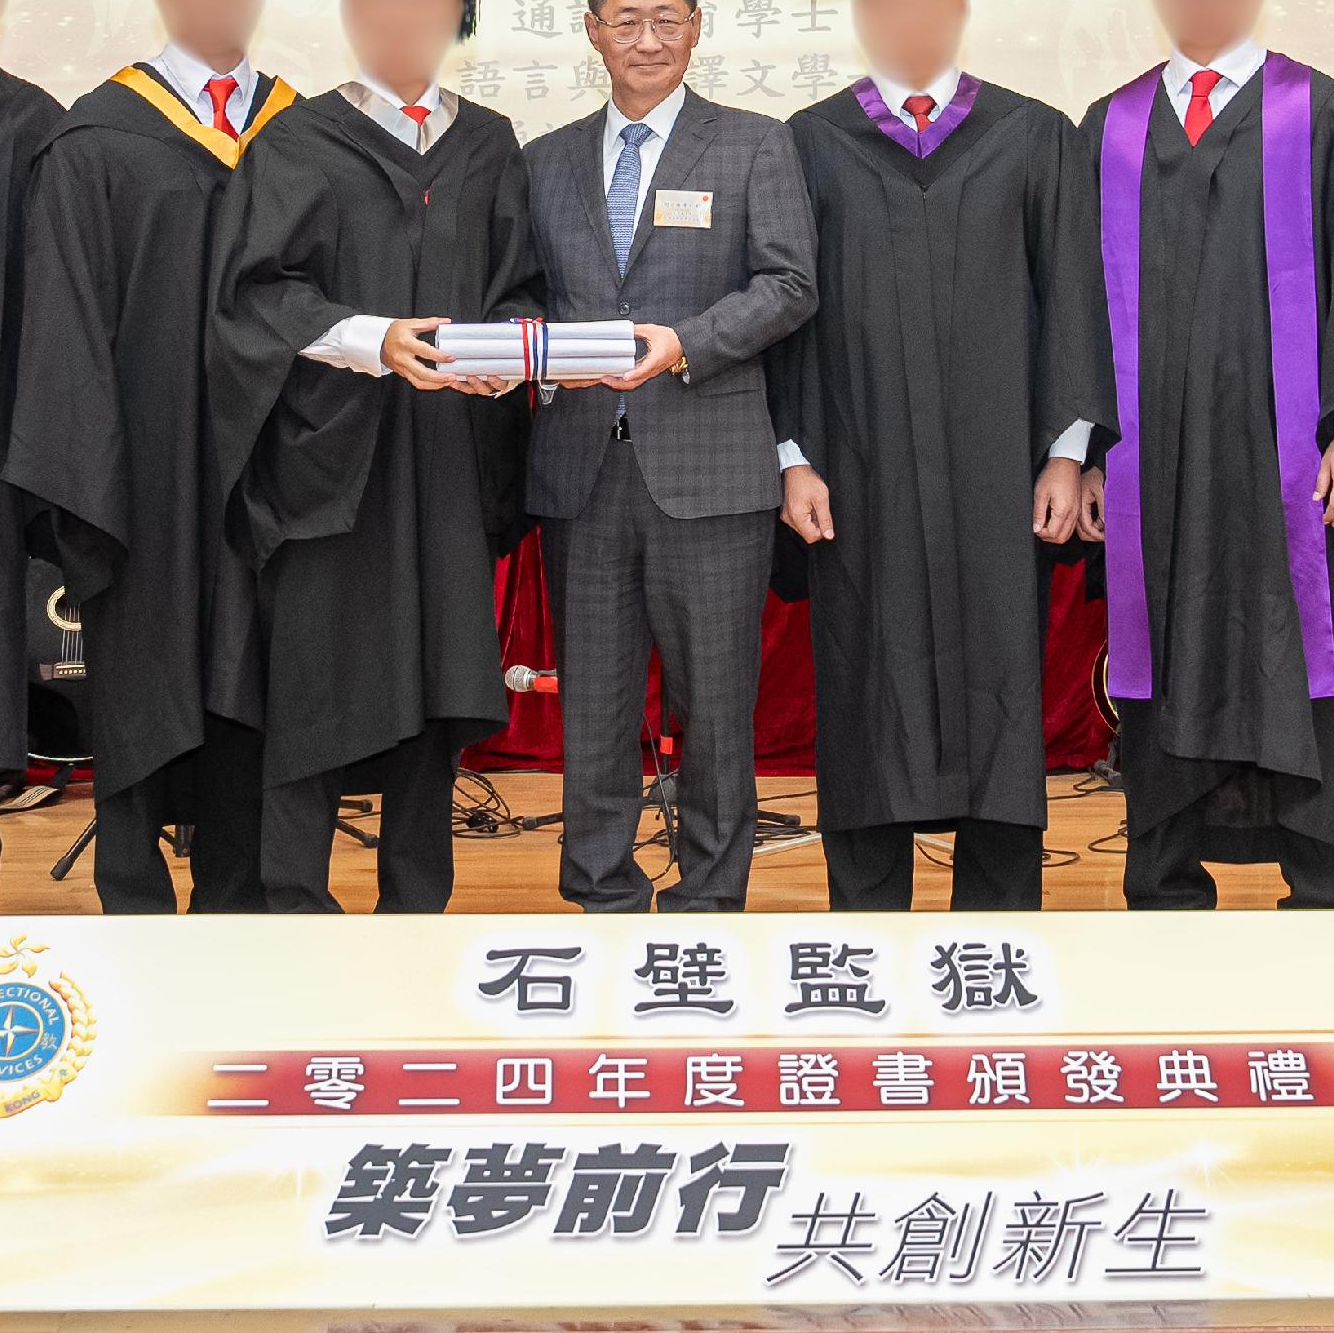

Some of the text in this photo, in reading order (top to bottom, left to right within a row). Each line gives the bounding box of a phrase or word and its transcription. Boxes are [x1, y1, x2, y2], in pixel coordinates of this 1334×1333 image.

[479, 941, 1041, 1015] 石壁監獄
[3, 1089, 41, 1114] KONG
[207, 1049, 1315, 1111] 二零二四年度證書頒發典禮
[324, 1142, 791, 1239] 築夢前行
[765, 1188, 1211, 1286] 共創新生
